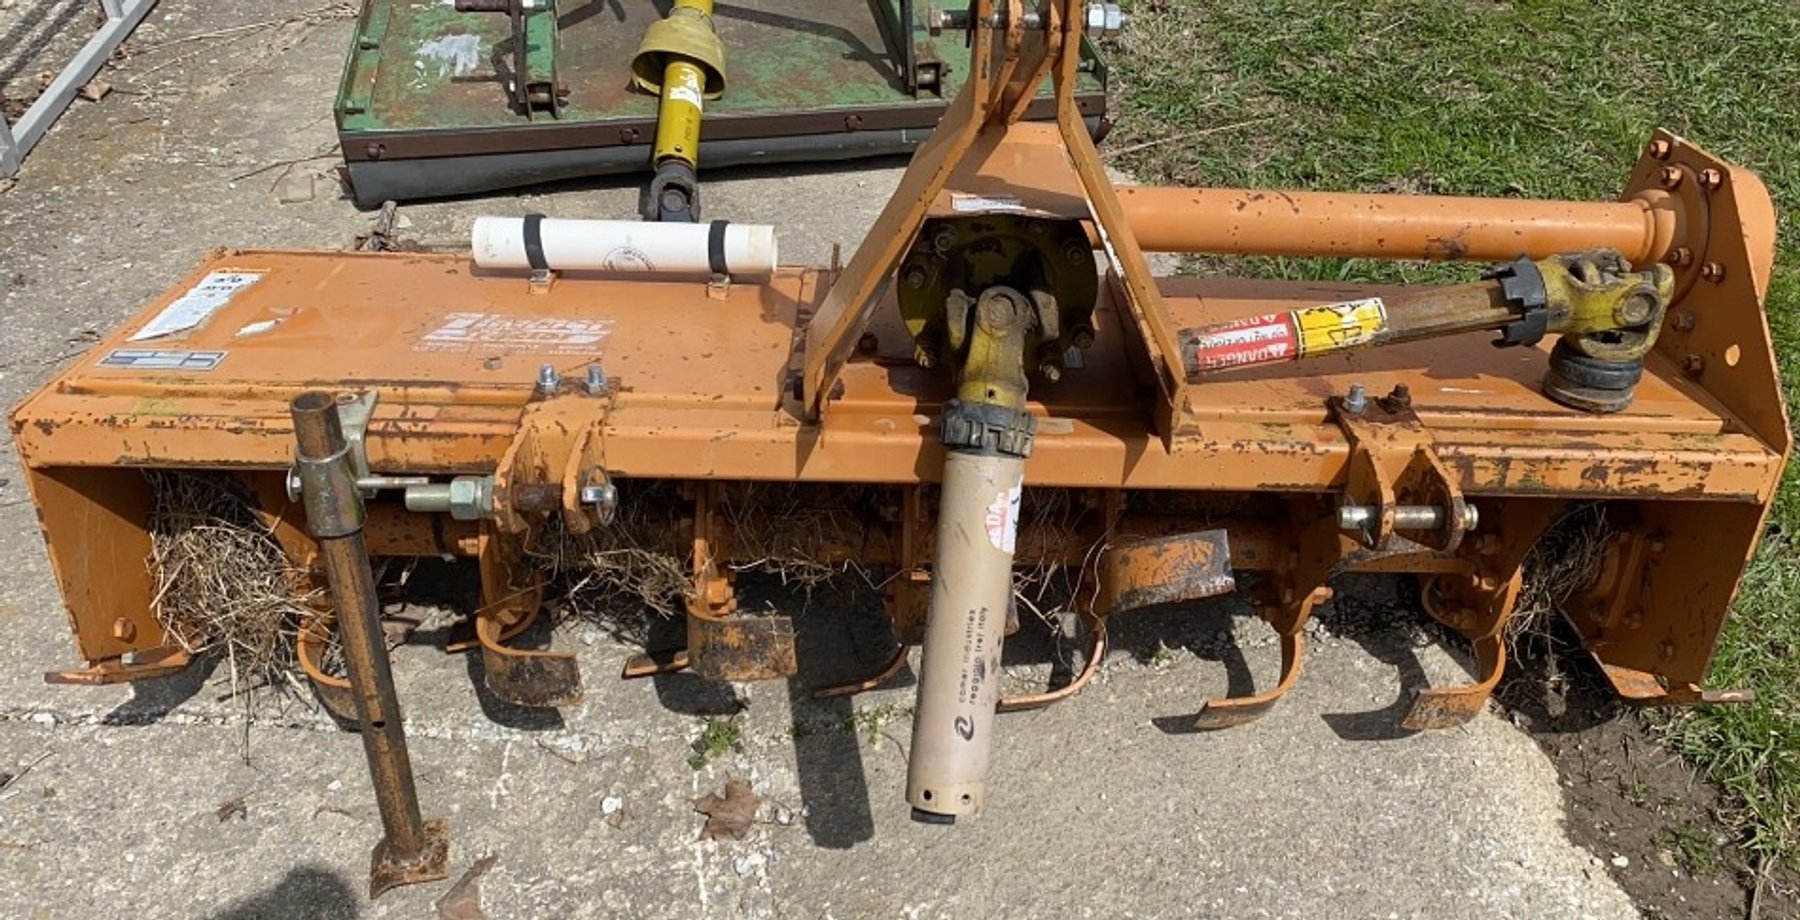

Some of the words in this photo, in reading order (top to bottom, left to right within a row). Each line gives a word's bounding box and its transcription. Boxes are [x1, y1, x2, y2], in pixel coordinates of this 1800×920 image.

[978, 606, 989, 629] italy
[963, 609, 976, 663] industries
[958, 668, 969, 703] comer
